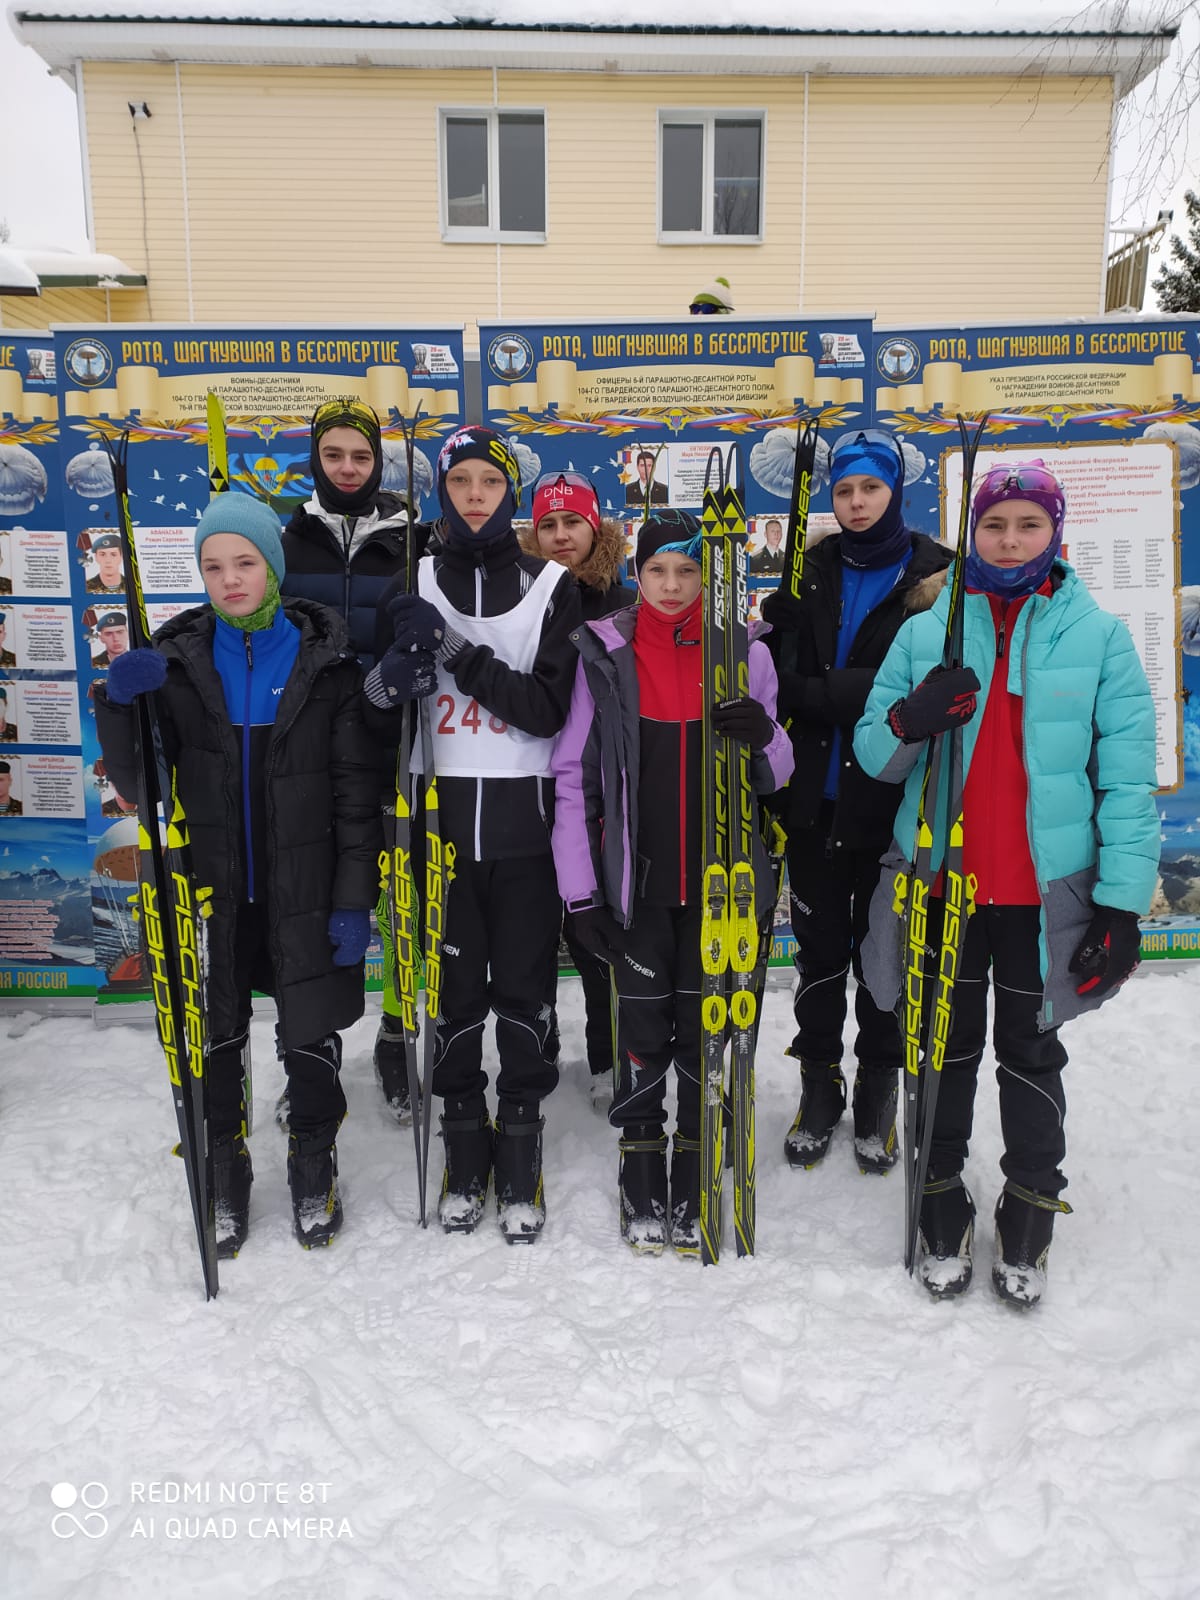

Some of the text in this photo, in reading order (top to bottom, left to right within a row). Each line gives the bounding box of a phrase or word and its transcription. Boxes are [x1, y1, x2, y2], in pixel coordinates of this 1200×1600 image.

[121, 341, 168, 365] РОТА,
[173, 341, 276, 363] ШАГНУВШАЯ
[281, 341, 291, 362] В
[297, 341, 400, 363] БЕССМЕРТИЕ
[543, 335, 586, 359] РОТА,
[592, 334, 688, 357] ШАГНУВШАЯ
[694, 333, 703, 355] В
[709, 331, 808, 355] БЕССМЕРТИЕ
[736, 374, 757, 382] РОТЫ
[930, 339, 971, 360] РОТА,
[977, 335, 1070, 358] ШАГНУВШАЯ
[1075, 334, 1085, 355] В
[1090, 331, 1186, 354] БЕССМЕРТИЕ
[544, 482, 574, 498] DNB
[791, 470, 812, 599] FISCHER
[714, 545, 725, 631] FISCHER
[736, 541, 748, 628] FISCHER
[394, 847, 416, 1031] FISCHER
[426, 831, 443, 1020] FISCHER
[17, 971, 68, 989] РОССИЯ
[141, 882, 182, 1087] FISCHER
[171, 871, 204, 1079] FISCHER
[907, 879, 929, 1077] FISCHER
[932, 870, 963, 1072] FISCHER
